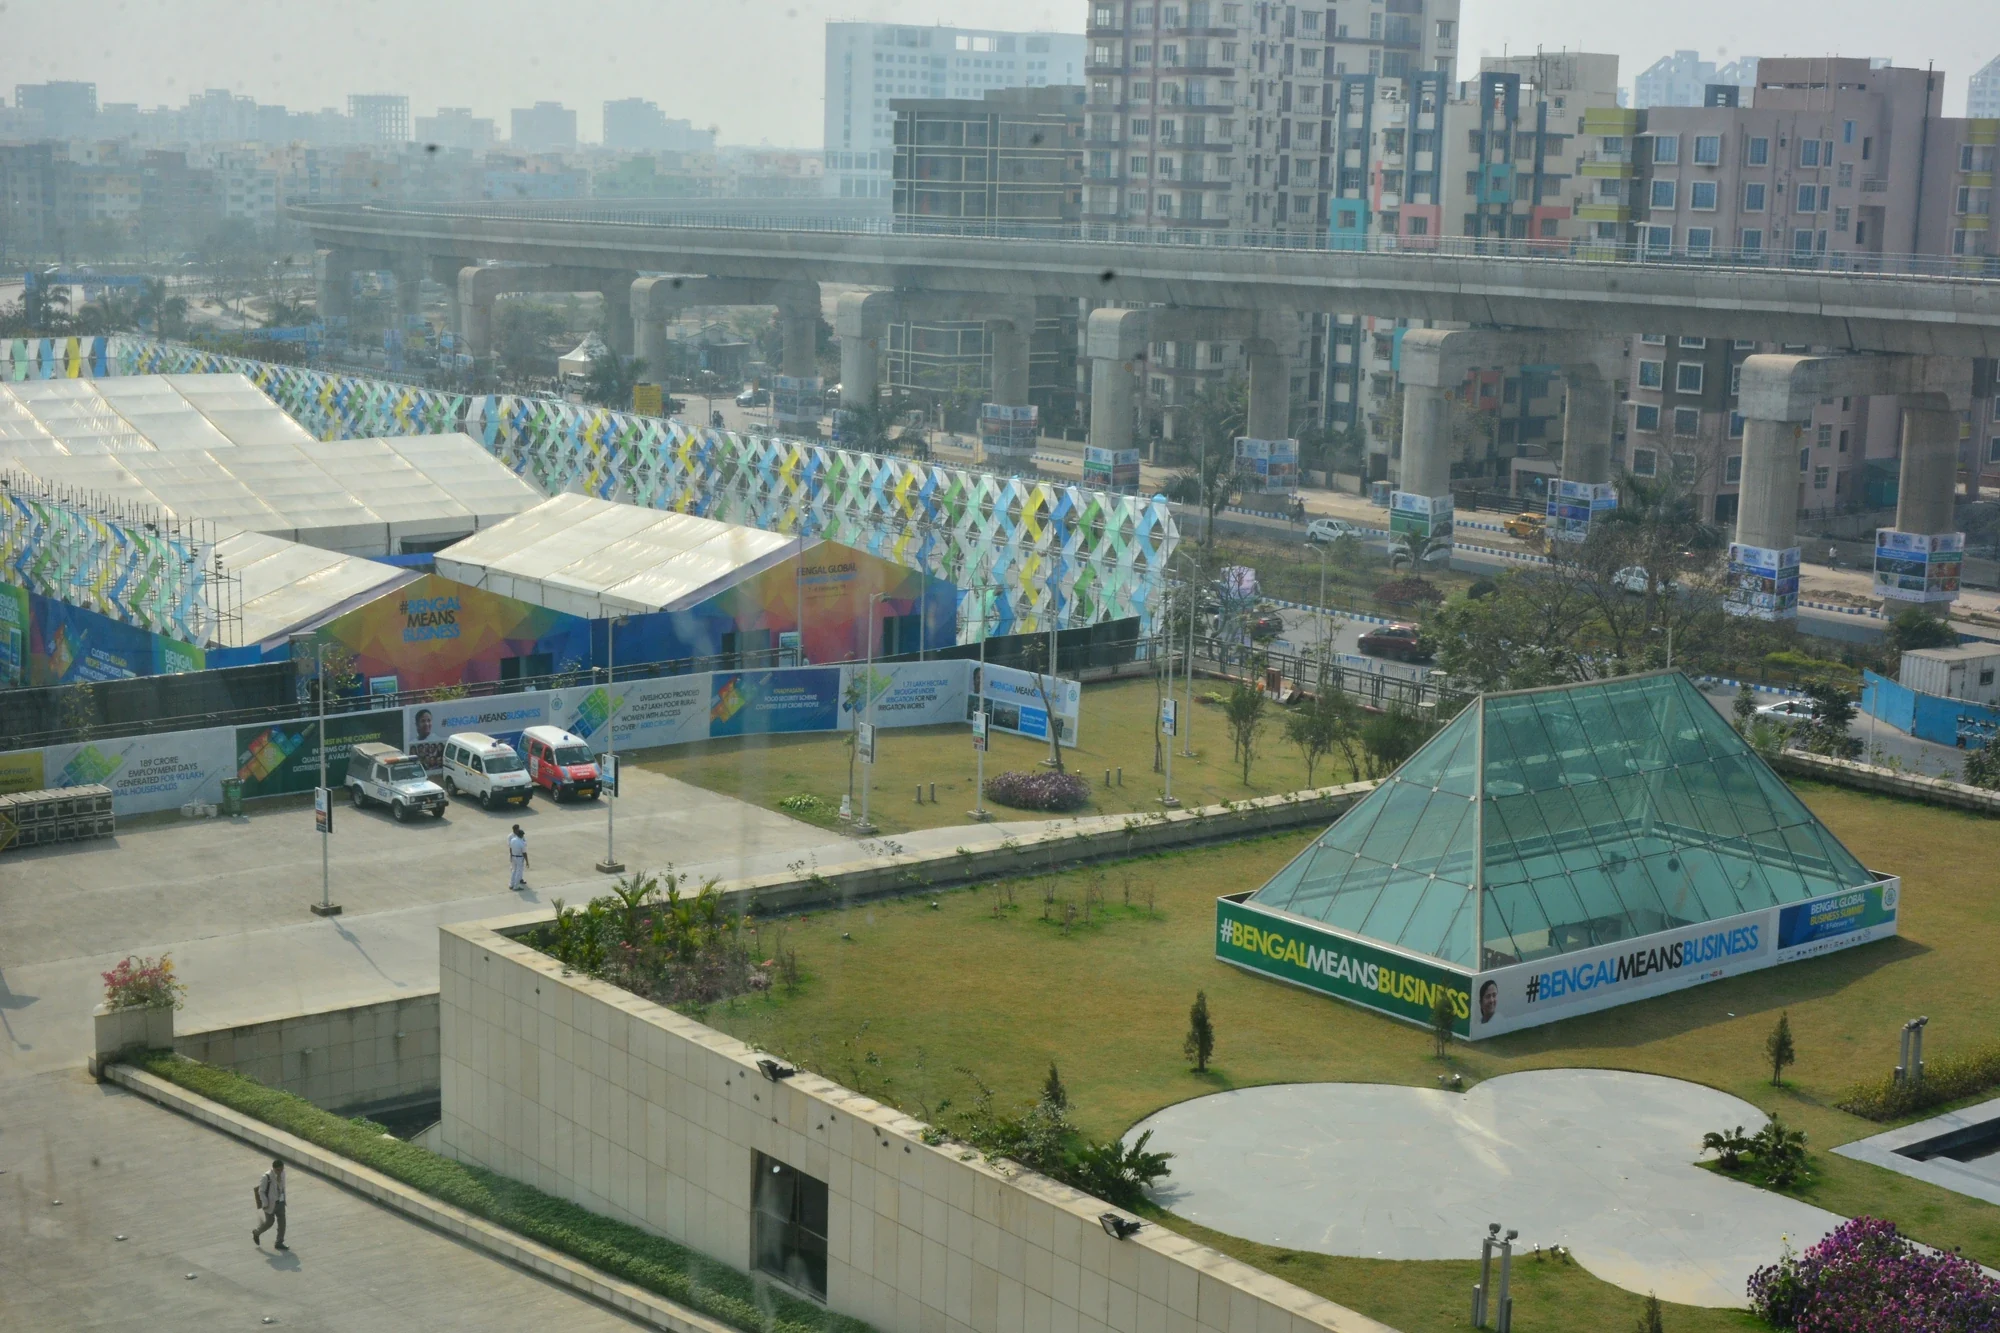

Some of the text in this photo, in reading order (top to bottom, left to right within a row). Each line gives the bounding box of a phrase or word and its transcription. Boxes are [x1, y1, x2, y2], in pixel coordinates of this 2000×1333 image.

[828, 562, 857, 573] GLOBAL
[407, 610, 455, 628] MEANS
[403, 624, 461, 643] BUSINESS
[165, 649, 193, 671] BENGAL
[663, 700, 680, 708] POOR
[441, 708, 542, 728] #BENGALMEANSBUSINESS
[621, 713, 645, 721] WOMEN
[660, 709, 681, 717] ACCESS
[620, 723, 636, 731] OVER
[353, 732, 382, 741] COUNTRY
[140, 756, 179, 767] 189 CRORE
[128, 762, 198, 777] EMPLOYMENT DAYS
[117, 771, 205, 788] GENERATED FOR 90 LAKH
[130, 783, 178, 795] HOUSEHOLDS
[1810, 893, 1866, 915] BENGAL GLOBAL
[1809, 911, 1840, 926] BUSINESS
[1526, 924, 1759, 1003] #BENGALMEANSBUSINESS
